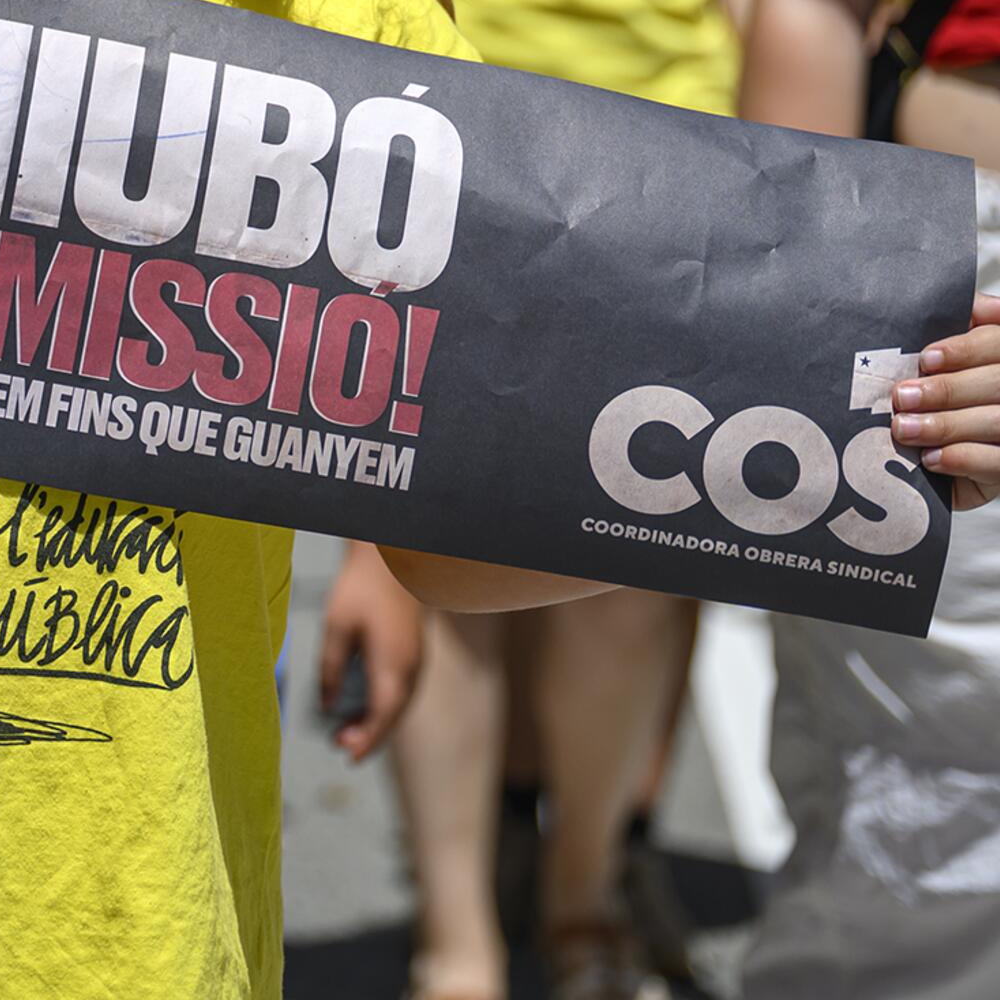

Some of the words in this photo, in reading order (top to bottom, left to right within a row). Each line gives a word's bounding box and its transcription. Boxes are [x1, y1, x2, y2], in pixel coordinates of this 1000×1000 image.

[46, 384, 138, 439] FINS
[139, 407, 222, 456] QUE
[223, 416, 414, 491] GUANYEM
[581, 517, 740, 557] COORDINADORA
[744, 547, 823, 573] OBRERA
[827, 560, 918, 590] SINDICAL
